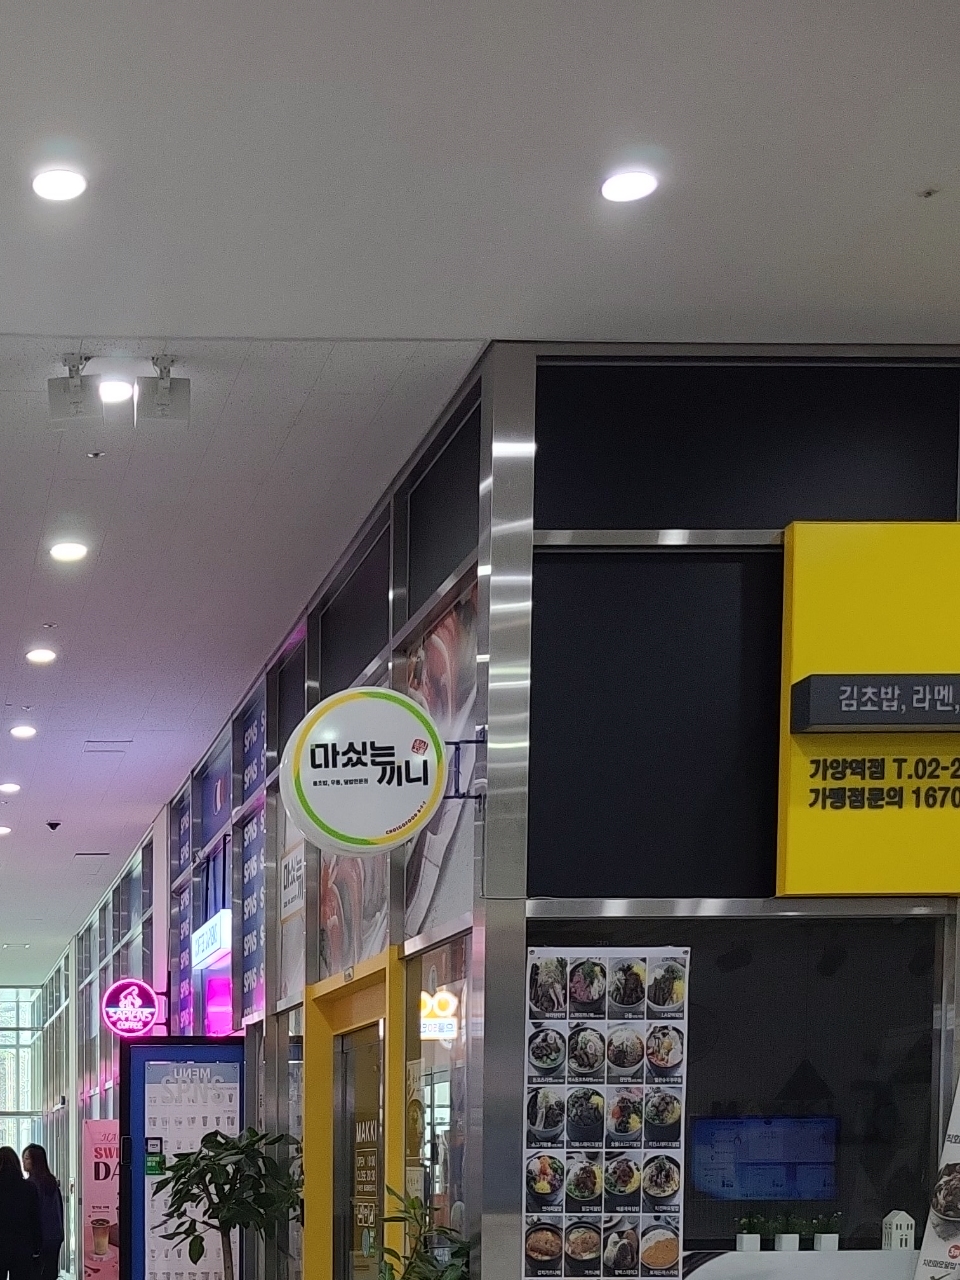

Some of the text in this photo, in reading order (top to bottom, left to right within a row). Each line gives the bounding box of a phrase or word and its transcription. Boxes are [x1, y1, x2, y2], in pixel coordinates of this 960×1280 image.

[839, 685, 906, 714] 김초밥,
[376, 759, 429, 787] 끼니
[809, 757, 886, 781] 가양역점
[107, 1009, 152, 1022] SAPIENS
[356, 1120, 377, 1143] MAKKI
